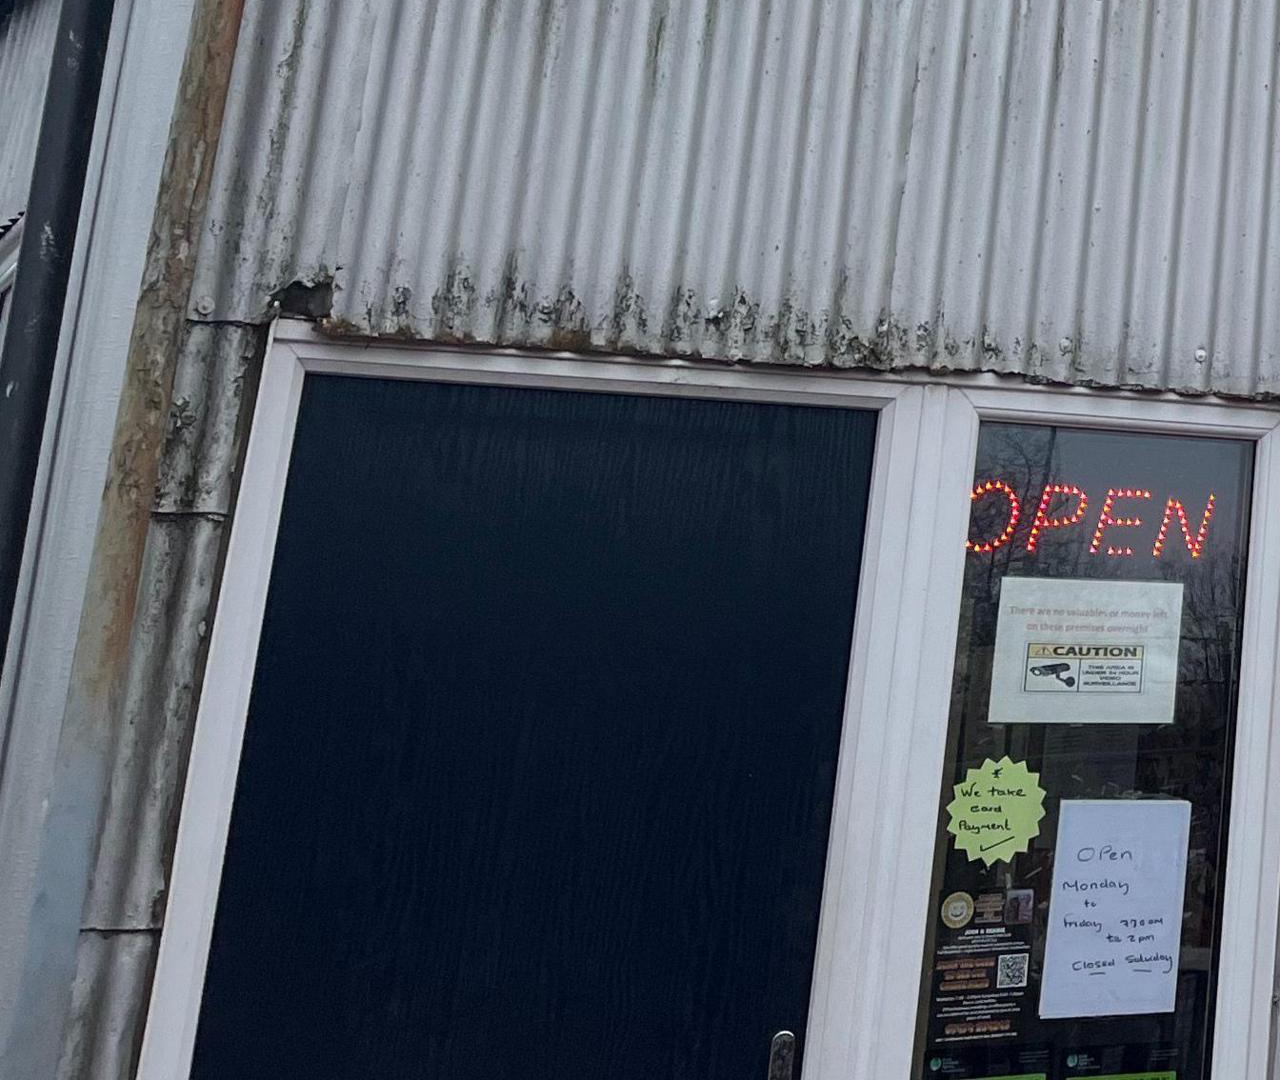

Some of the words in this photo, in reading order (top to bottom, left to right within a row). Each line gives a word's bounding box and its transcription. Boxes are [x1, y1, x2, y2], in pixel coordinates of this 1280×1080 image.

[966, 479, 1216, 558] OPEN
[1009, 605, 1035, 615] There
[1037, 607, 1051, 616] are
[1053, 609, 1065, 617] no
[1066, 607, 1107, 618] valuables
[1121, 610, 1150, 621] money
[1026, 623, 1038, 631] on
[1040, 622, 1063, 632] these
[1065, 623, 1105, 635] premises
[1107, 624, 1148, 637] overnight
[1053, 646, 1138, 657] CAUTION
[961, 781, 980, 797] We
[988, 786, 1027, 797] take
[959, 818, 1011, 834] Payment
[1062, 878, 1129, 895] Monday
[1084, 899, 1097, 908] to
[1063, 914, 1102, 932] Friday
[1072, 959, 1116, 971] Closed
